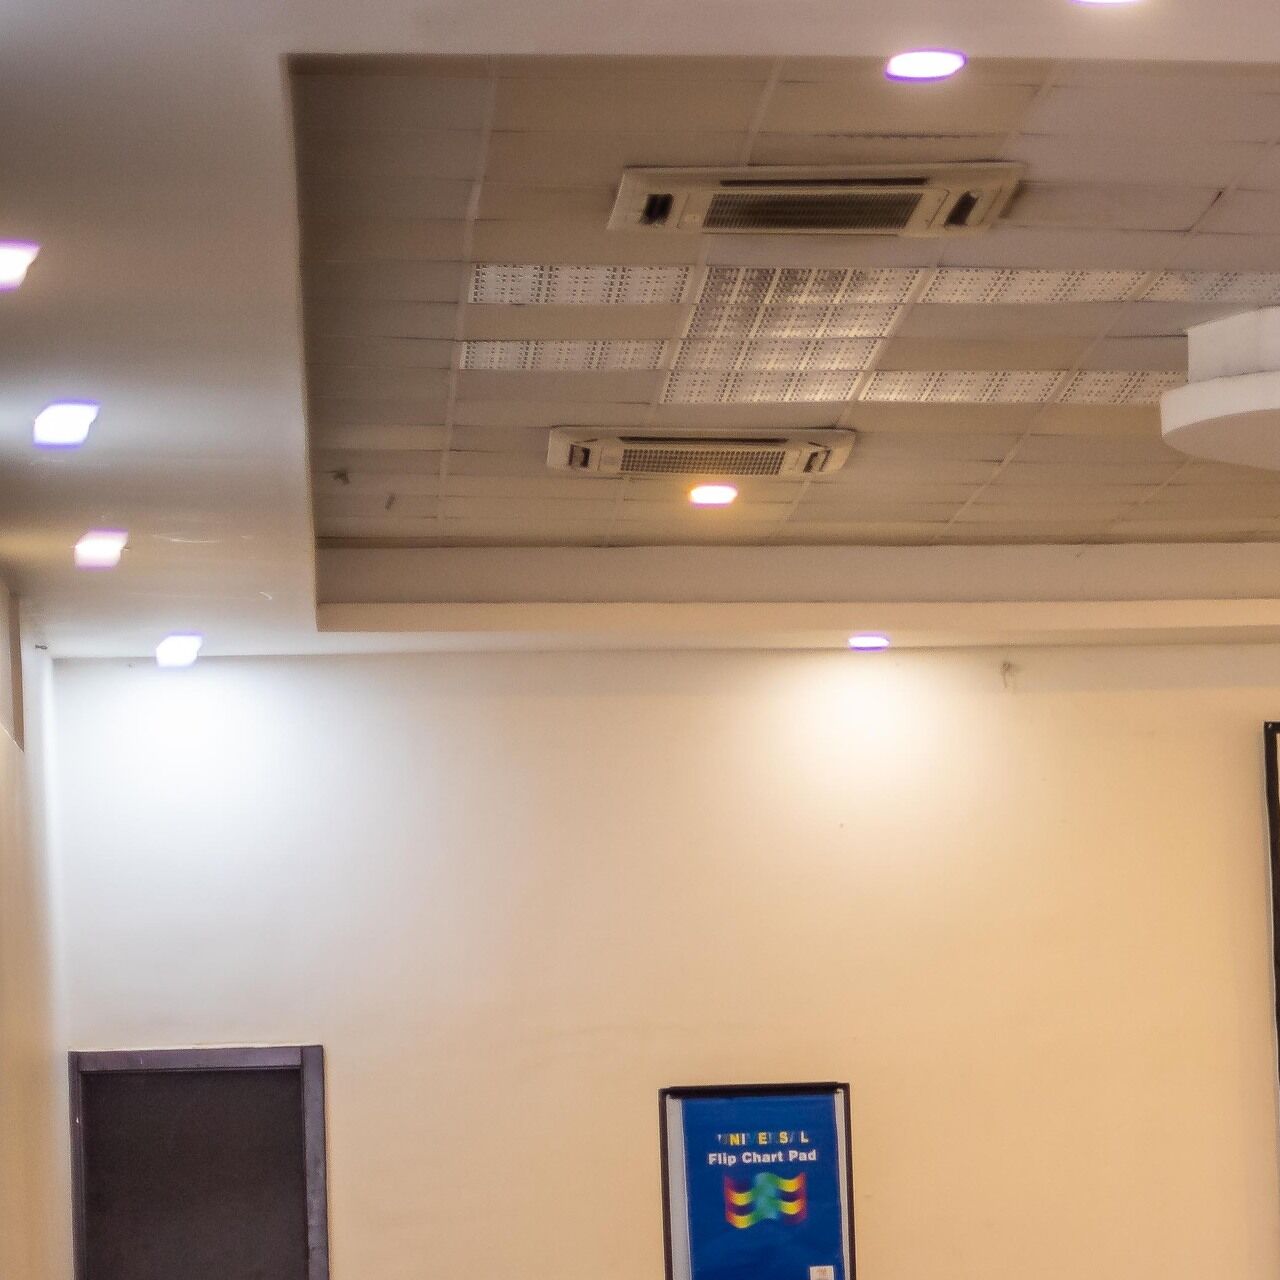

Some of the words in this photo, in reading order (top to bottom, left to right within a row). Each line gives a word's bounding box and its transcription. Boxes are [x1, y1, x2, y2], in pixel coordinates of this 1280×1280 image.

[708, 1152, 737, 1167] Flip
[741, 1150, 784, 1164] Chart
[788, 1148, 817, 1162] Pad
